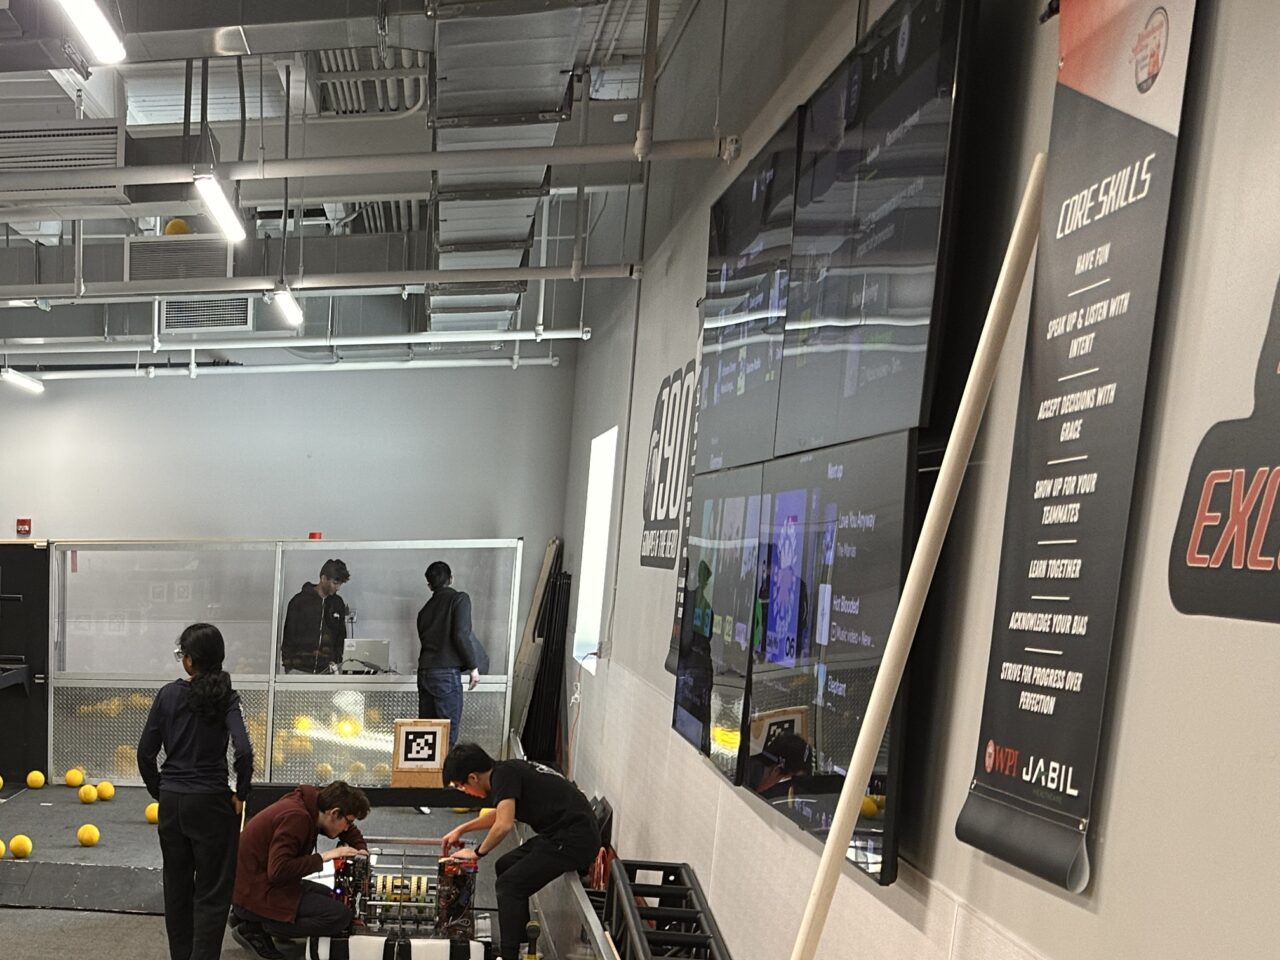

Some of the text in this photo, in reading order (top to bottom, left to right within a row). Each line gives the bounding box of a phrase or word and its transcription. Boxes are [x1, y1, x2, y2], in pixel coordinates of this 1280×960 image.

[1056, 152, 1156, 240] CORE SKILLS
[1075, 242, 1111, 275] HAVE FUN
[1046, 292, 1131, 340] SPEAK UP & LISTEN WITH
[1068, 332, 1096, 359] INTENT
[1037, 383, 1117, 421] ACCEPT DECISIONS WITH
[650, 370, 695, 521] 190
[1060, 419, 1083, 442] GRACE
[1033, 472, 1098, 499] SHOW UP FOR YOUR
[1042, 503, 1080, 525] TEAMMATES
[1028, 558, 1082, 579] LEARN TOGETHER
[1008, 612, 1088, 635] ACKNOWLEDGE YOUR BIAS
[1000, 661, 1083, 692] STRIVE FOR PROGRESS OVER
[1019, 690, 1056, 715] PERFECTION
[995, 745, 1019, 777] WPI
[1022, 755, 1079, 797] JABIL
